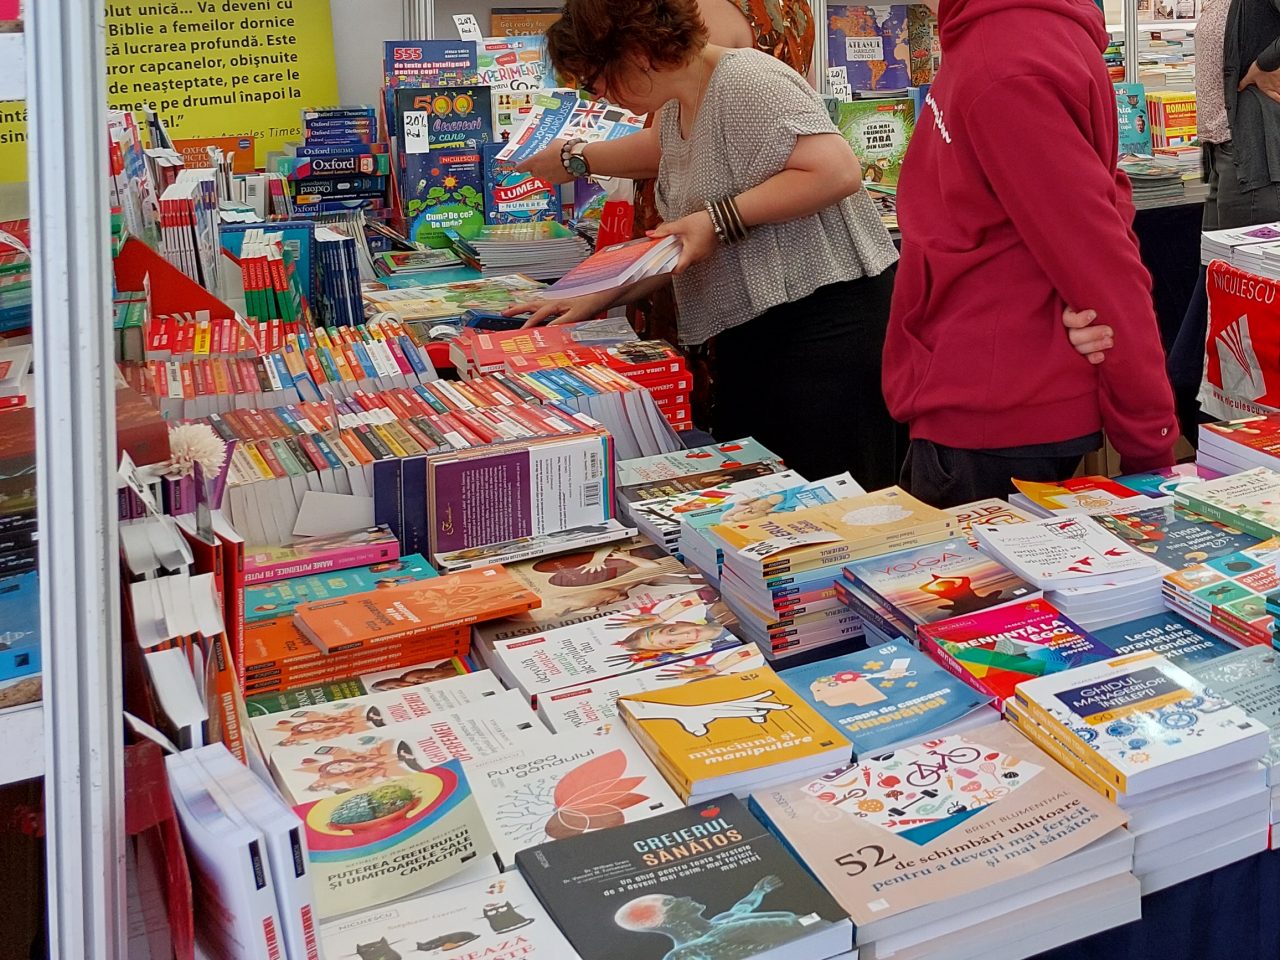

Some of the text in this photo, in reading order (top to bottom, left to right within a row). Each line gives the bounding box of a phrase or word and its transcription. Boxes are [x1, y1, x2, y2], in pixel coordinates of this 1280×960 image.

[103, 5, 132, 18] olut
[198, 1, 216, 14] Va
[222, 0, 270, 12] deveni
[276, 0, 293, 10] cu
[109, 17, 295, 37] Biblie a femeilor dornice
[124, 40, 186, 56] lucrarea
[190, 36, 263, 55] profundă.
[267, 34, 296, 47] Este
[394, 47, 422, 60] 555
[848, 39, 881, 49] ATLASUL
[105, 51, 298, 76] uror capcanelor, obişnuite
[109, 81, 129, 95] de
[231, 74, 249, 89] pe
[253, 71, 283, 84] care
[287, 68, 300, 82] le
[161, 98, 179, 114] pe
[183, 93, 236, 109] drumul
[240, 88, 286, 107] înapoi
[289, 87, 301, 100] la
[413, 93, 474, 116] 500
[536, 114, 555, 140] JOCURI
[549, 101, 573, 135] LAROUSSE
[269, 126, 301, 138] Times
[304, 147, 330, 155] Oxford
[312, 157, 355, 171] Oxford
[300, 185, 331, 195] Oxford
[500, 179, 543, 200] LUMEA
[1213, 271, 1276, 305] NICULESCU
[1213, 391, 1270, 415] www.niculescu.r
[313, 559, 333, 571] MAME
[876, 550, 963, 576] YOGA
[958, 618, 1066, 651] RENUNŢĂ LA
[1117, 627, 1195, 656] pravieţuire
[1124, 622, 1183, 643] Lecţii de
[1164, 640, 1214, 660] xtreme
[1072, 676, 1167, 709] MANAGERILOR
[1080, 675, 1142, 699] GHIDUL
[838, 687, 951, 725] scapă de capcana
[430, 721, 474, 762] UPERFEMEII
[688, 735, 776, 761] minciună
[704, 734, 813, 766] manipulare
[487, 753, 558, 780] Puterea
[515, 747, 596, 779] gândului
[964, 790, 1072, 834] BRETT BLUMENTHAL
[633, 817, 733, 853] CREIERUL
[642, 828, 743, 866] SĂNĂTOS
[834, 797, 1081, 877] 52 de schimbări uluitoare
[1004, 843, 1036, 860] mai
[1039, 811, 1100, 847] sănătos
[327, 828, 469, 882] PUTEREA CREIERULUI
[345, 849, 439, 885] UIMITOARELE
[440, 835, 472, 854] SALE
[872, 805, 1091, 892] pentru a deveni mai fericit
[635, 872, 656, 884] ghid
[658, 864, 688, 878] pentru
[690, 856, 713, 869] toate
[715, 844, 752, 862] vârstele
[720, 862, 738, 873] mai
[603, 888, 616, 897] de
[627, 878, 658, 892] deveni
[660, 873, 677, 884] mai
[706, 859, 723, 871] mai
[338, 911, 393, 931] NICULESCU
